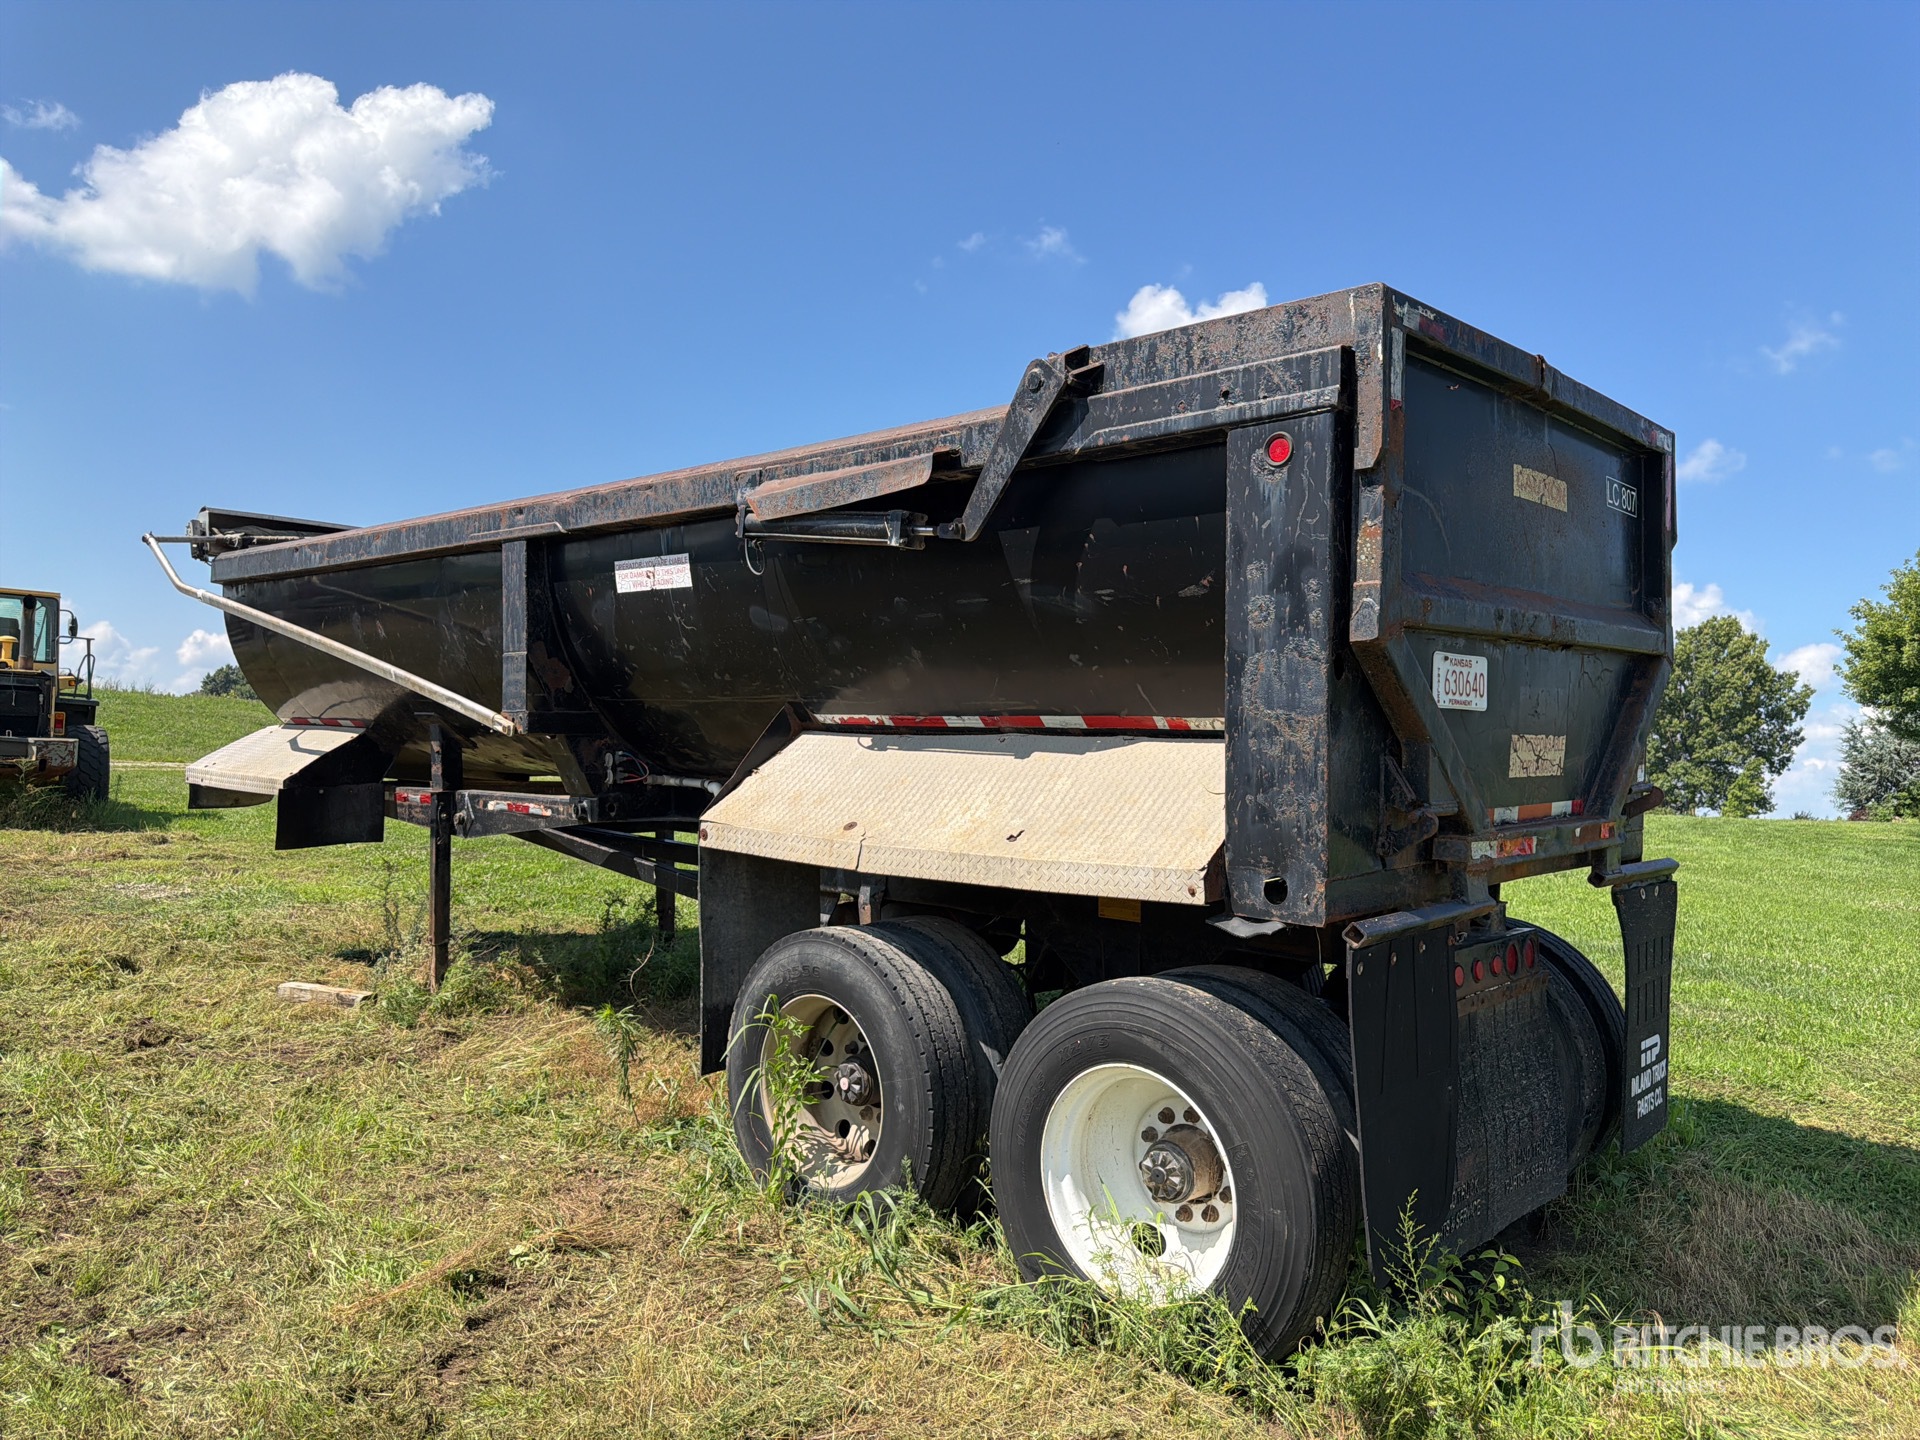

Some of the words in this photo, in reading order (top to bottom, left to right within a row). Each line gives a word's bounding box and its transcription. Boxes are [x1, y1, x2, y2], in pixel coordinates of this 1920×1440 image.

[1607, 480, 1620, 506] LC
[1621, 487, 1636, 513] 807
[618, 572, 629, 580] FOR
[661, 568, 673, 577] THIS
[675, 566, 687, 575] UNIT
[632, 580, 649, 589] WHILE
[1450, 657, 1473, 669] KANSAS
[1444, 669, 1485, 698] 630640
[1448, 698, 1473, 706] PERMANENT
[1631, 1068, 1652, 1098] INLAND
[1637, 1091, 1655, 1119] PARTS
